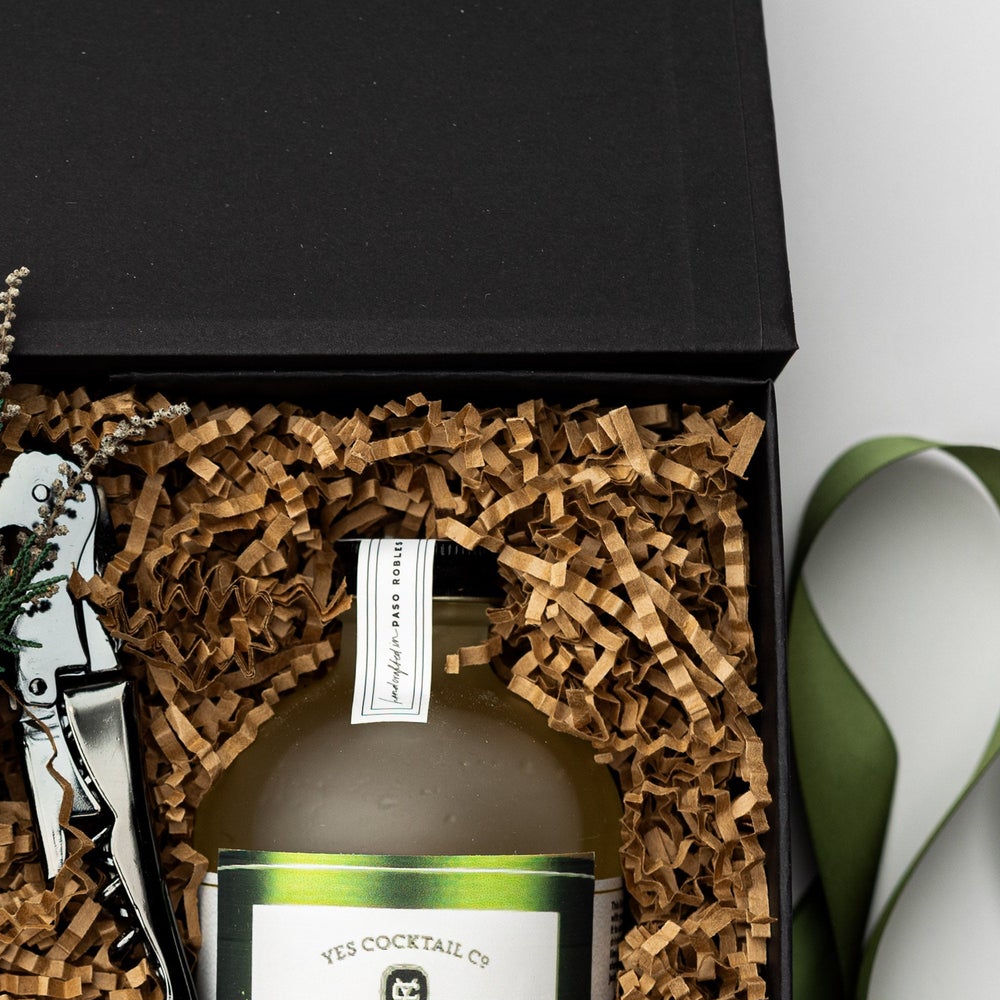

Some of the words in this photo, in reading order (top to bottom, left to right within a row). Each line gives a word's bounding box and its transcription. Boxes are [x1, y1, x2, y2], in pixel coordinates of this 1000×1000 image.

[392, 541, 403, 585] ROBLES
[391, 593, 400, 627] PASO
[321, 940, 357, 965] YES
[361, 934, 463, 958] COCKTAIL
